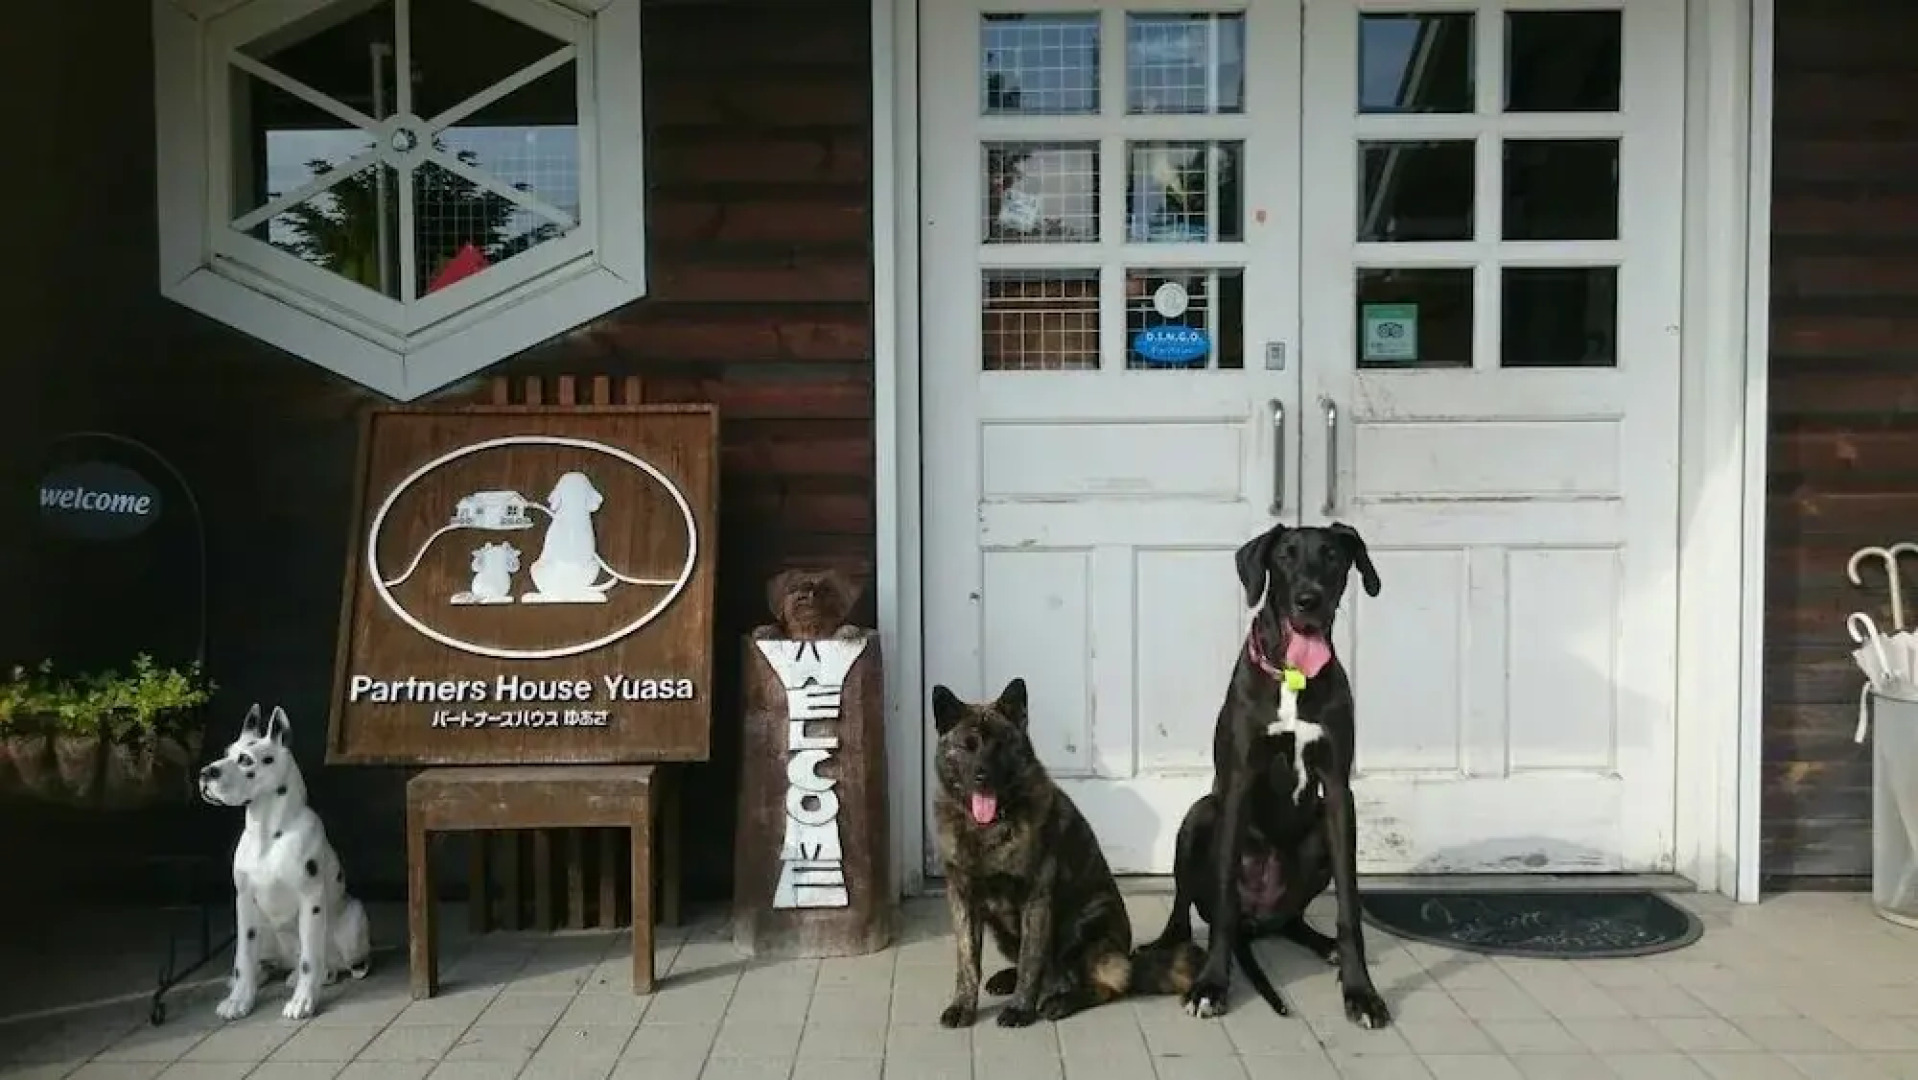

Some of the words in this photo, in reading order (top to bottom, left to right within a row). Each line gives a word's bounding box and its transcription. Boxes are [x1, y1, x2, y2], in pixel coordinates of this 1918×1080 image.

[40, 487, 152, 515] welcome
[350, 674, 487, 702] Partners
[496, 674, 592, 701] House
[603, 673, 694, 700] Yuasa
[755, 639, 868, 908] WELCOME
